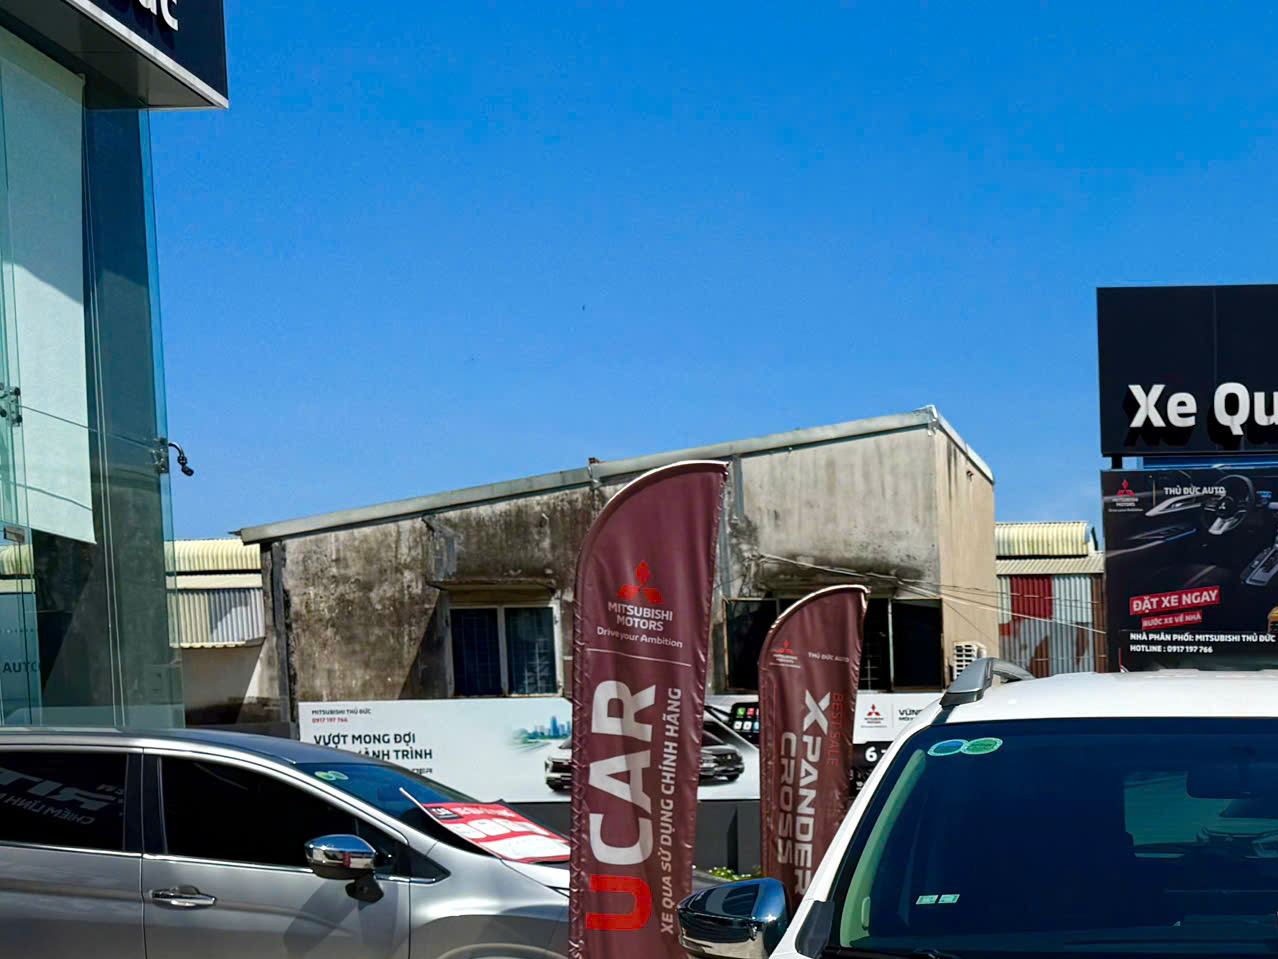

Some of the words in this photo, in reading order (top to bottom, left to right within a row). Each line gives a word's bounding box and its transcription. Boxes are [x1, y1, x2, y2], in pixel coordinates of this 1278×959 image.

[1128, 384, 1198, 428] Xe
[1200, 486, 1226, 495] AUTO
[607, 601, 673, 621] MITSUBISHI
[1132, 595, 1158, 613] ĐẶT
[1161, 595, 1179, 608] XE
[1182, 589, 1219, 605] NGAY
[616, 614, 664, 631] MOTORS
[597, 626, 619, 638] Drive
[620, 632, 640, 641] your
[640, 634, 683, 648] Ambition
[1130, 632, 1148, 641] NHÀ
[1241, 632, 1258, 642] THỦ
[1130, 644, 1162, 652] HOTLINE
[1167, 645, 1184, 653] 0917
[1185, 645, 1198, 653] 197
[662, 688, 681, 737] HÃNG
[313, 733, 348, 749] VƯỢT
[351, 733, 391, 745] MONG
[394, 732, 416, 747] ĐỢI
[393, 746, 433, 760] TRÌNH
[658, 741, 678, 795] CHÍNH
[777, 731, 797, 864] CROSS
[794, 688, 831, 896] XPANDER
[585, 680, 656, 931] UCAR
[660, 799, 676, 846] DỤNG
[657, 847, 672, 873] SỬ
[661, 876, 676, 909] QUA
[661, 912, 674, 935] XE
